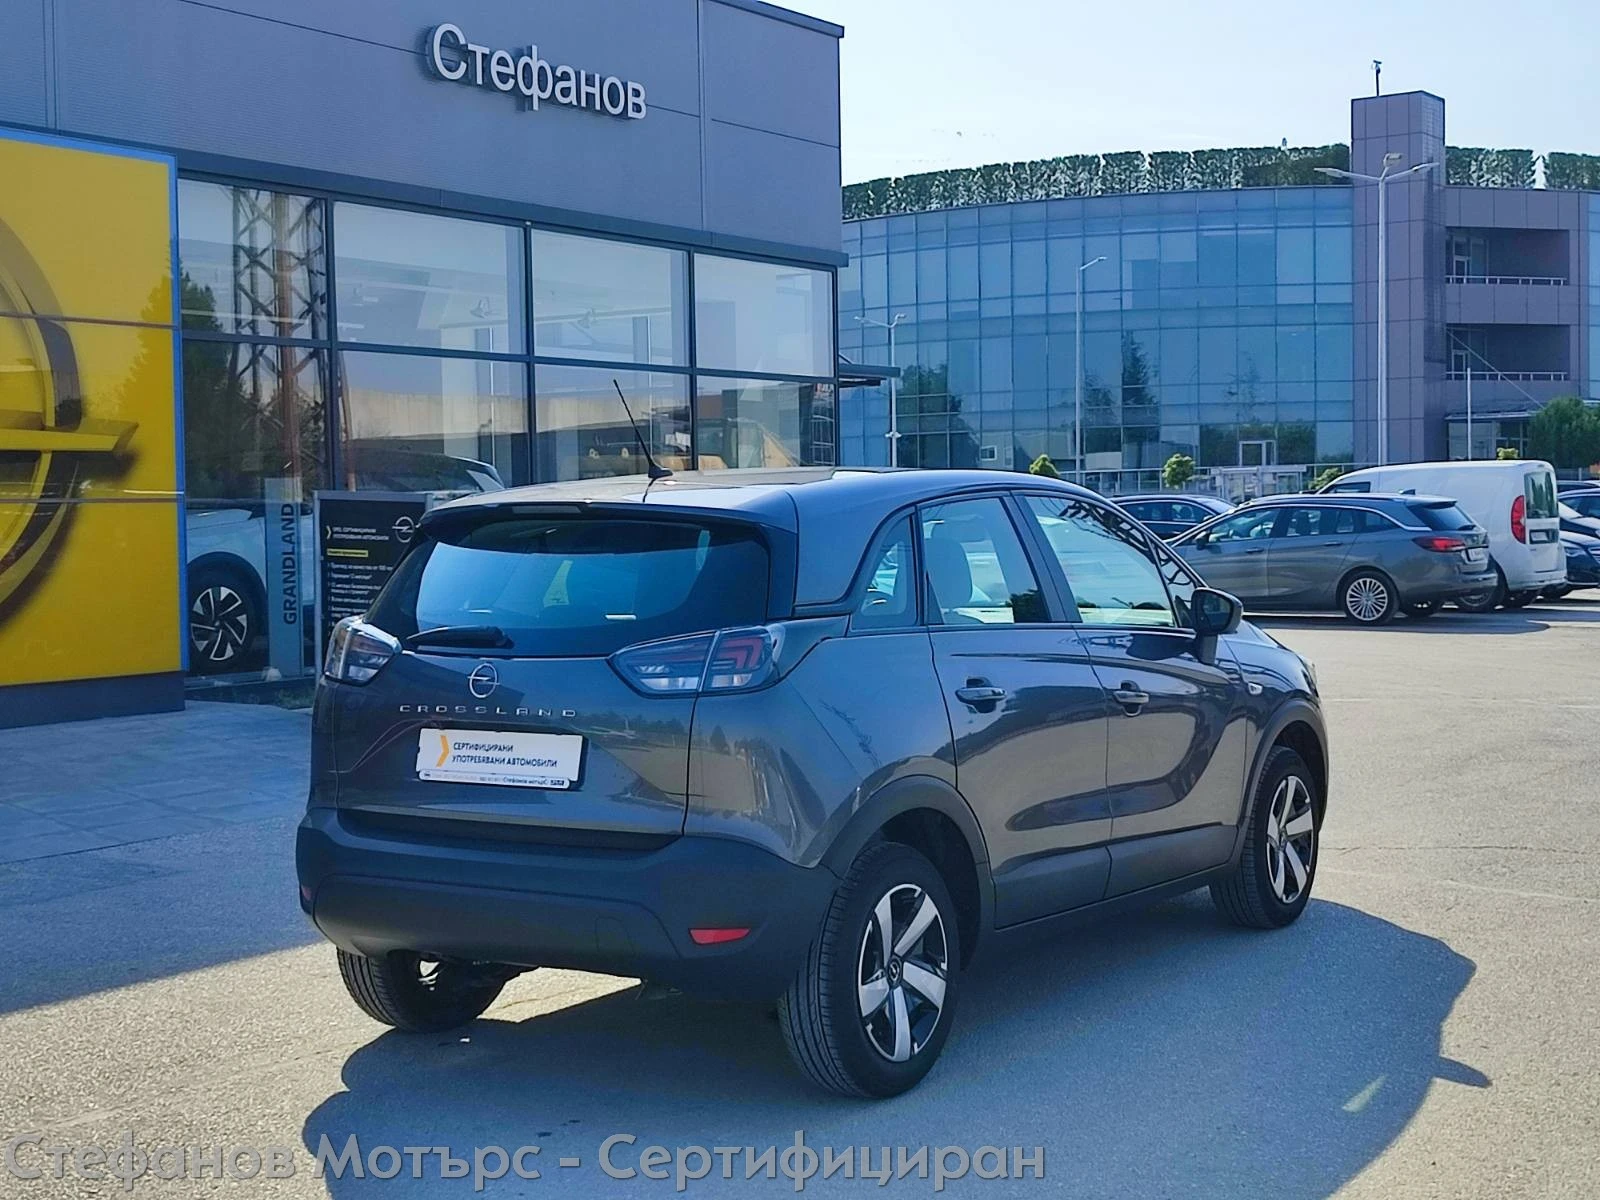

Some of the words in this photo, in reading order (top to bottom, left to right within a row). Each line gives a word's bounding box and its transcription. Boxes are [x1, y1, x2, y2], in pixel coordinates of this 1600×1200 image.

[431, 22, 648, 120] Стефанов
[280, 503, 298, 625] GRANDLAND
[399, 704, 577, 718] CROSSLAND
[453, 741, 514, 753] СЕРТИФИЦИРАНИ
[451, 754, 506, 765] УПОТРЕБЯВАНИ
[506, 757, 558, 768] АВТОМОБИЛИ
